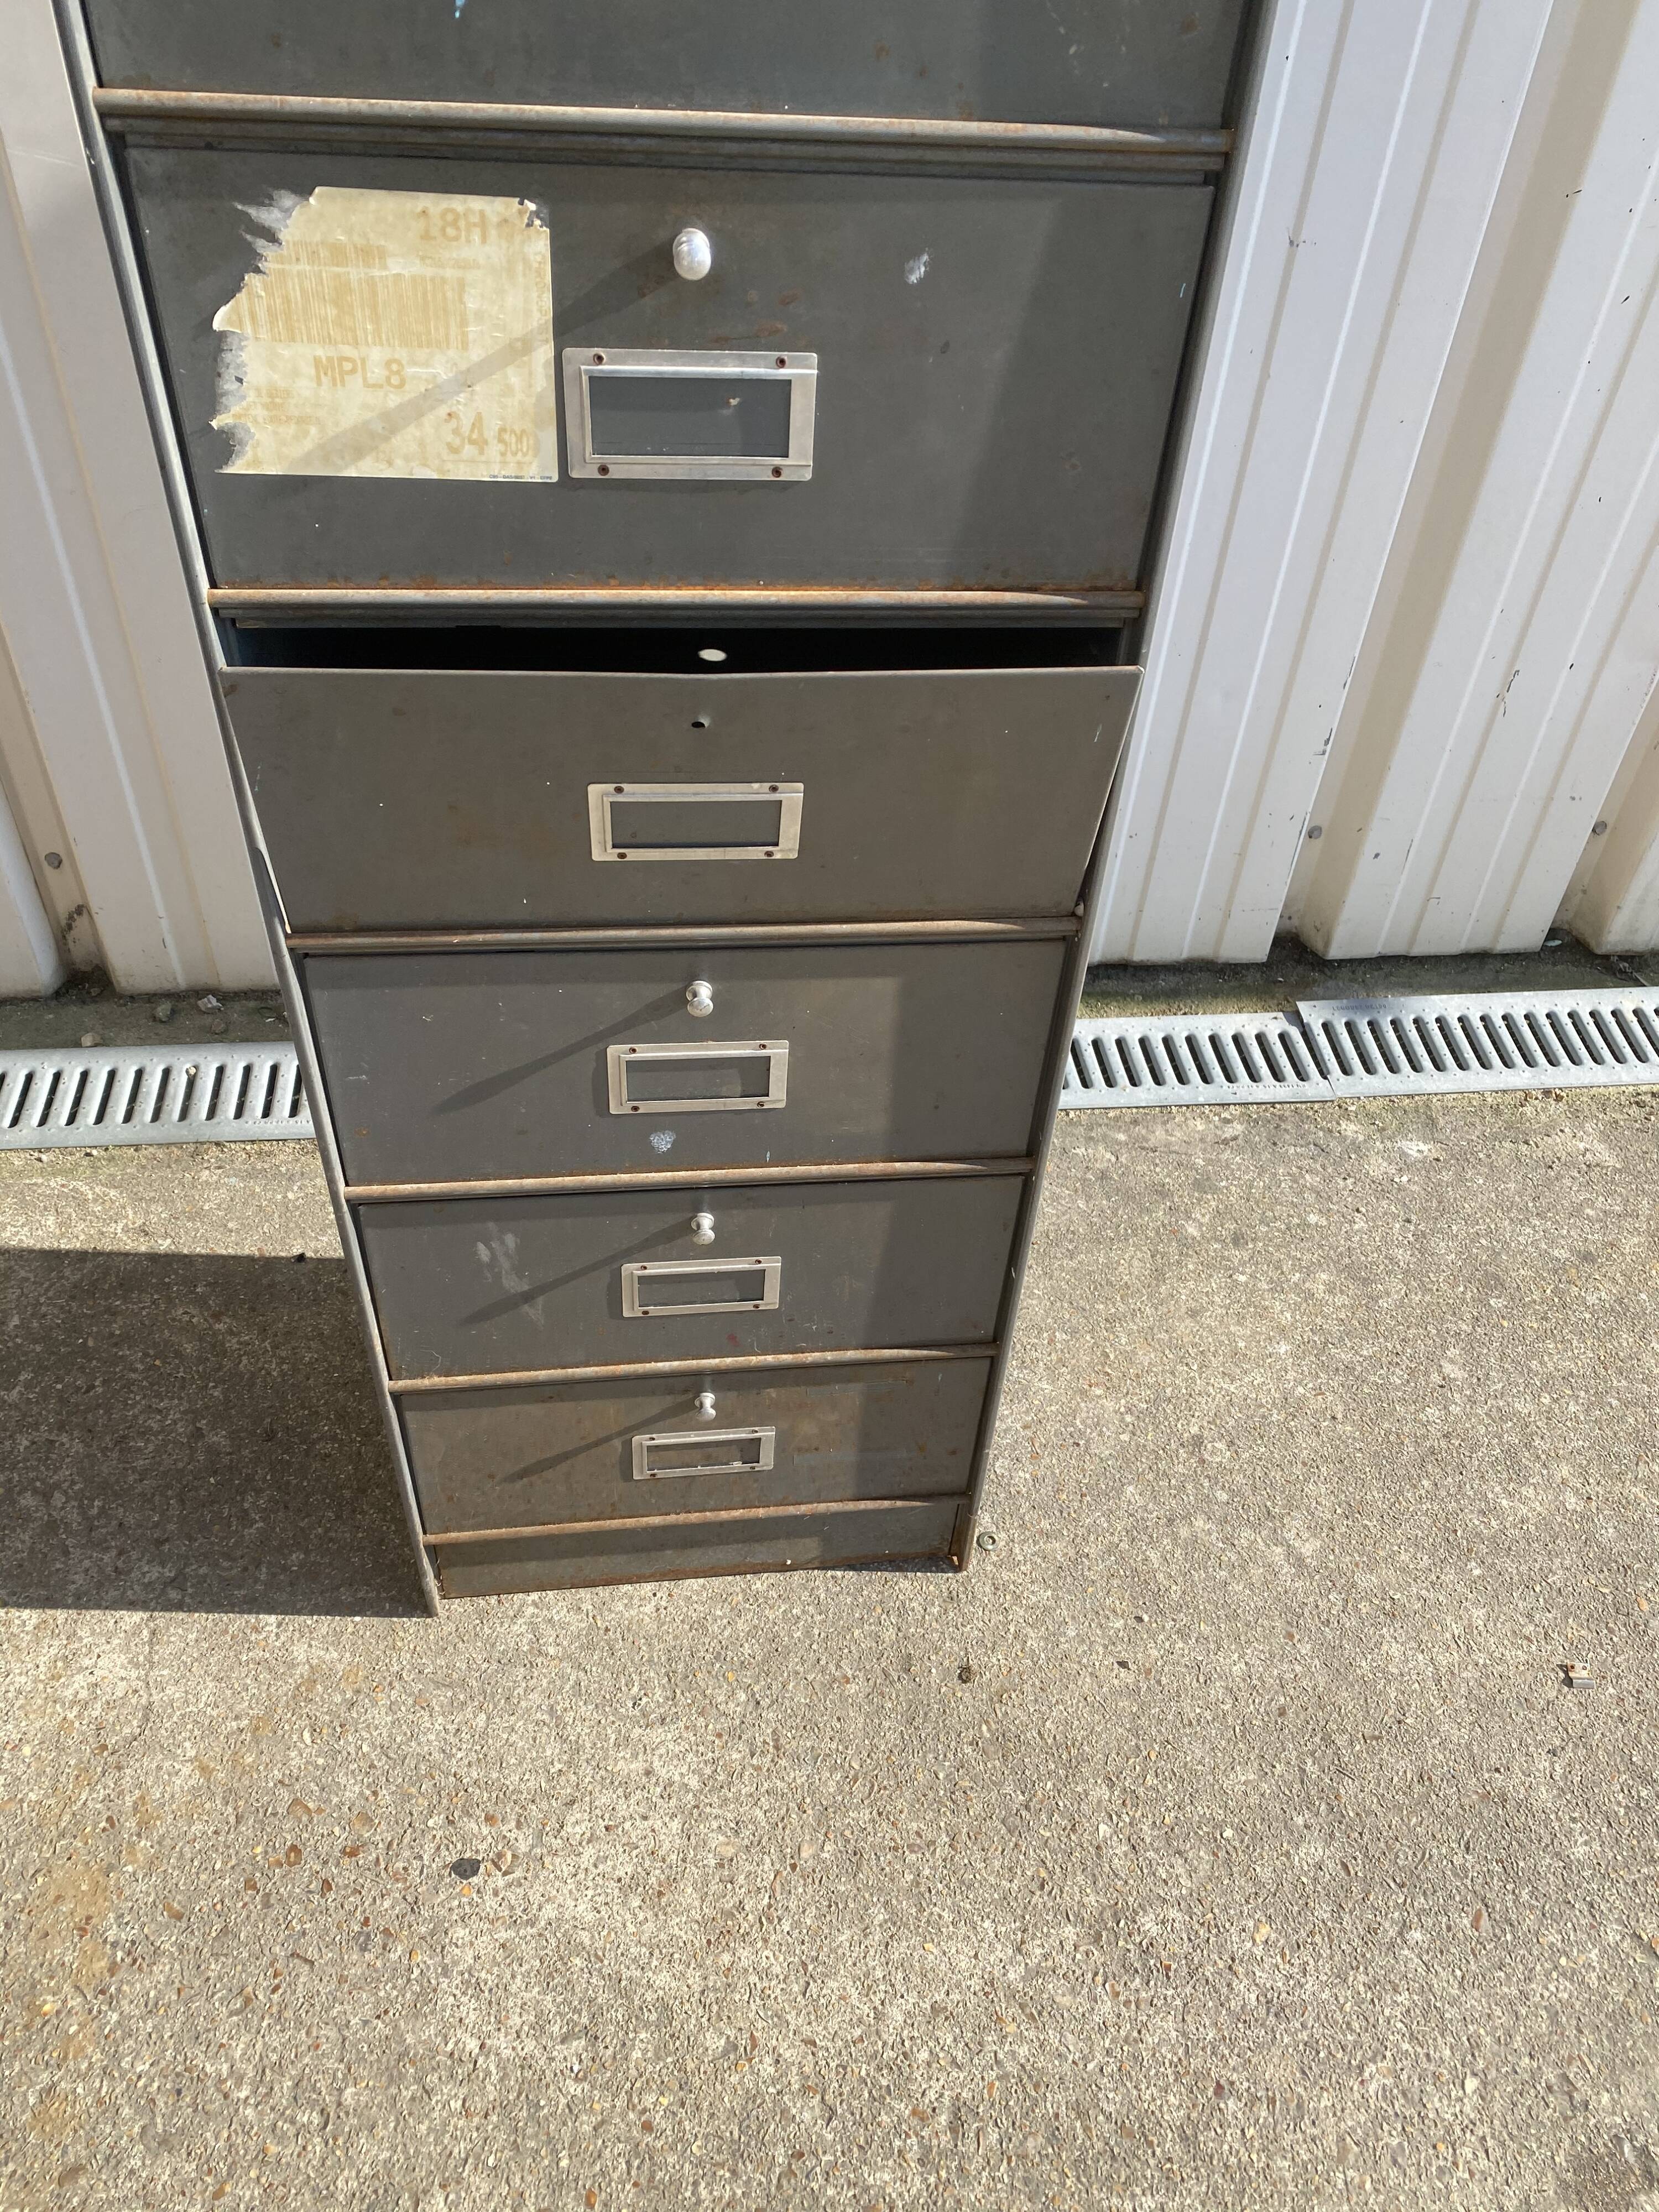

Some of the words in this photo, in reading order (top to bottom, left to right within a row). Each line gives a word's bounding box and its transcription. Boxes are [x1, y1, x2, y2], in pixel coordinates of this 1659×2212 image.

[416, 206, 488, 244] 18H
[314, 355, 407, 390] MPL8
[444, 411, 488, 455] 34
[497, 426, 530, 457] 500
